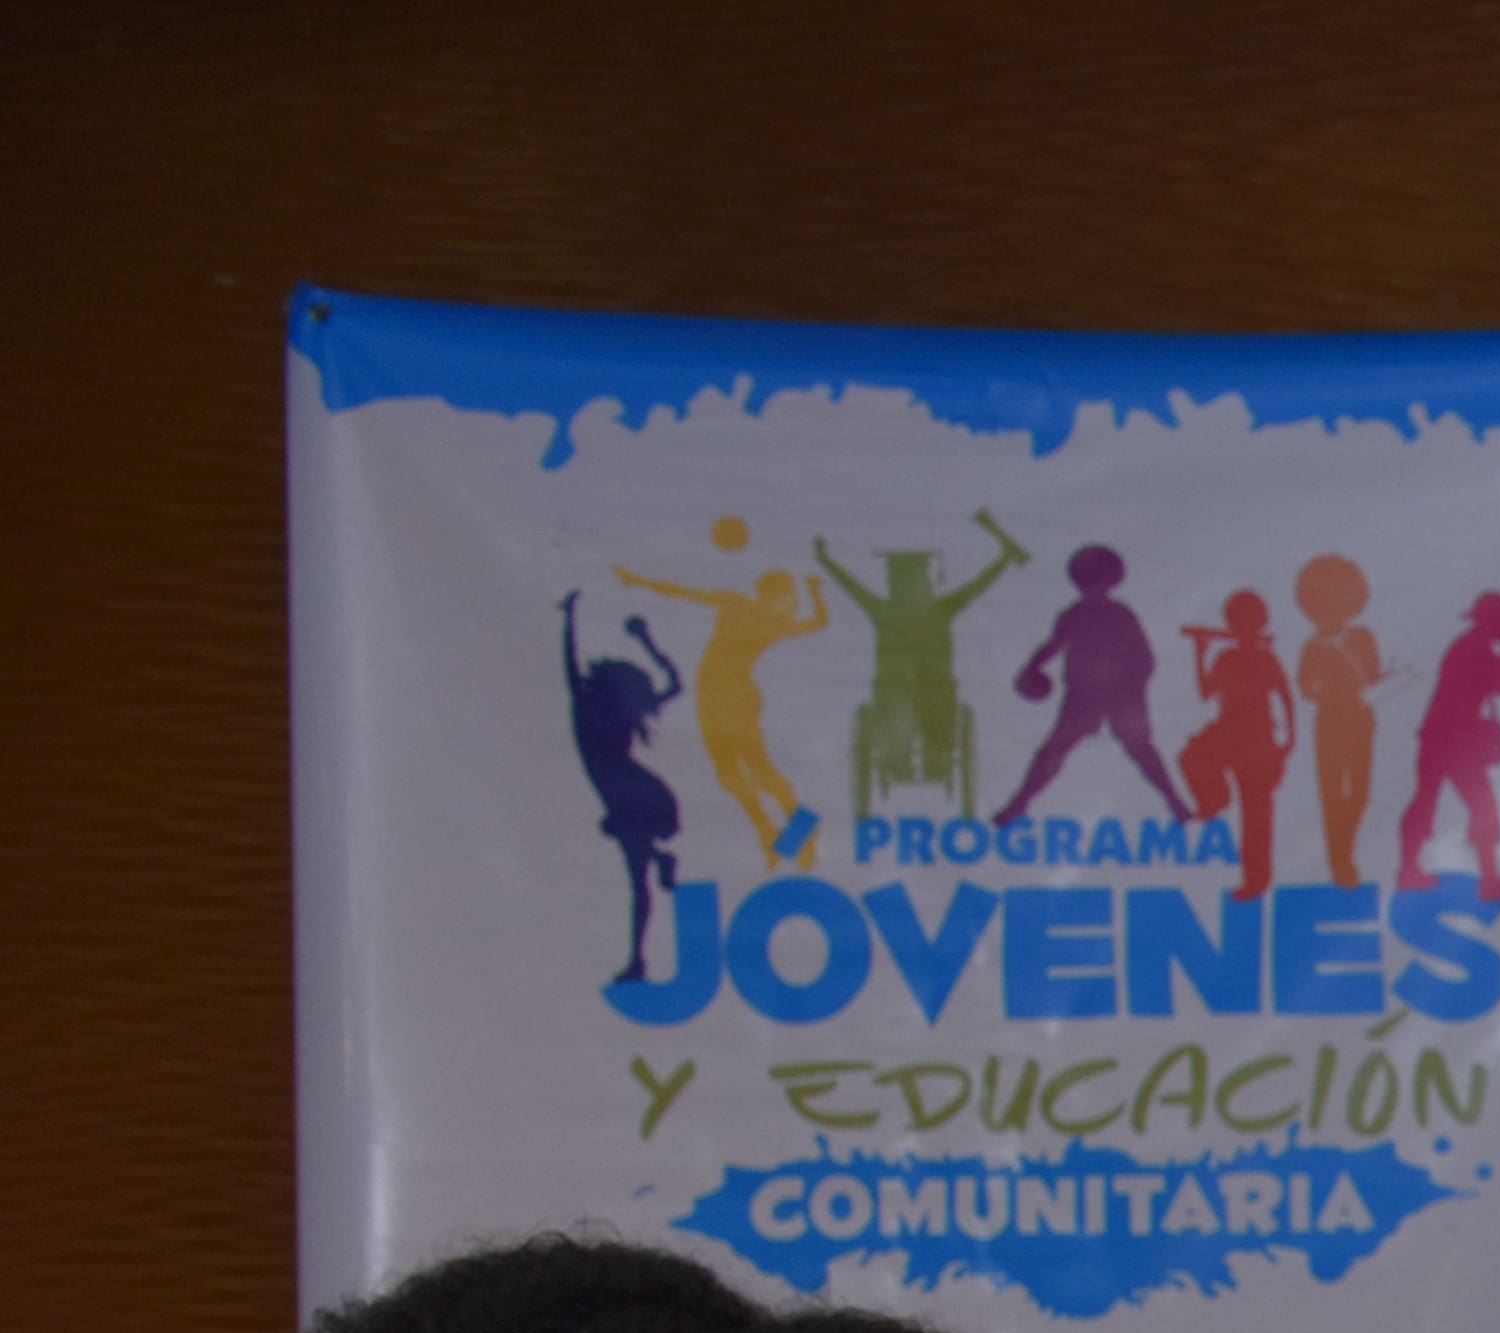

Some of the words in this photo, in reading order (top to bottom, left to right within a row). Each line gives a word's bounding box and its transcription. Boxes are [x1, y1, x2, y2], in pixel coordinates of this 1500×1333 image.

[854, 816, 1240, 865] PROGRAMA
[629, 1056, 695, 1140] Y
[769, 1009, 1487, 1137] EDUCACIÓN
[748, 1170, 1376, 1244] COMUNITARIA
